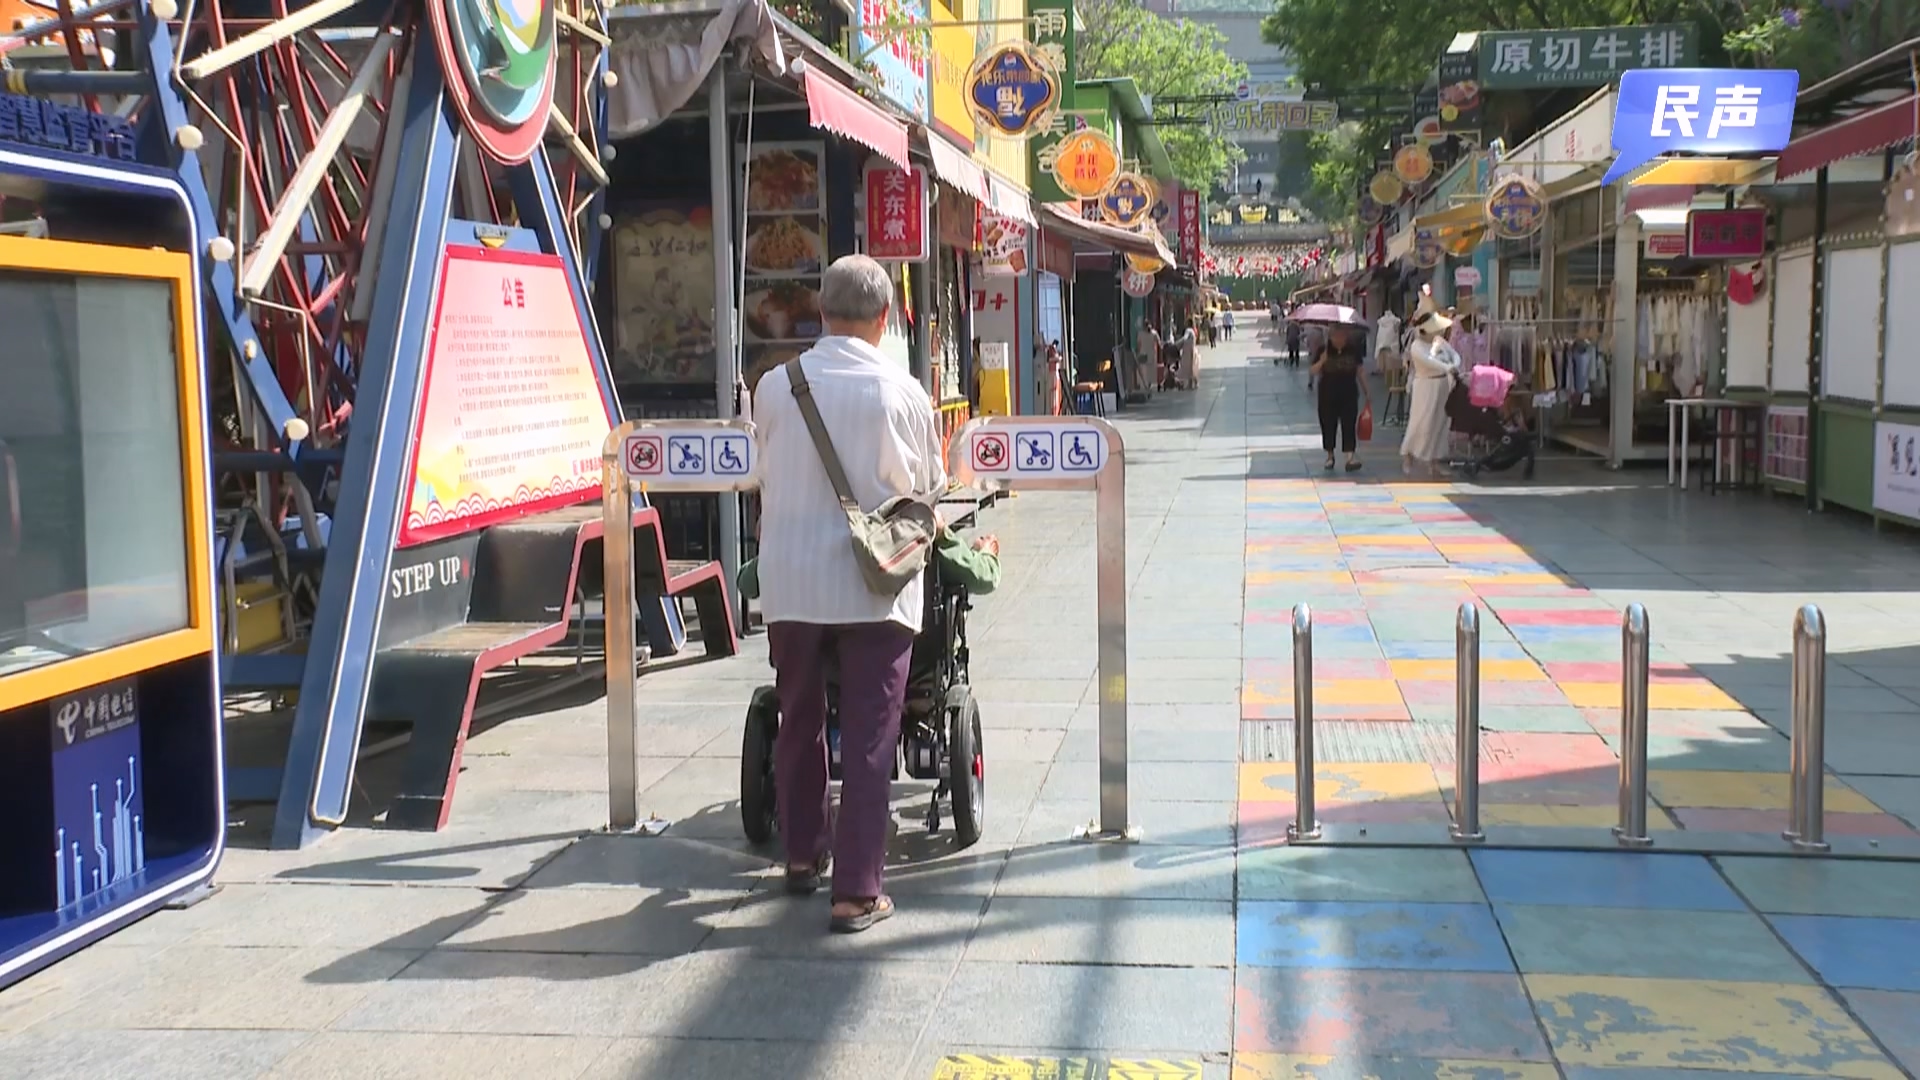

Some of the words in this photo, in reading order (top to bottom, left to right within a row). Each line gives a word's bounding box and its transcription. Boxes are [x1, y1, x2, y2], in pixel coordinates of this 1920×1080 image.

[1490, 29, 1685, 75] 原切牛排
[883, 170, 907, 240] 关东煮
[502, 277, 525, 309] 公告
[392, 562, 434, 598] STEP
[439, 556, 460, 586] UP
[84, 687, 134, 729] 中国电信
